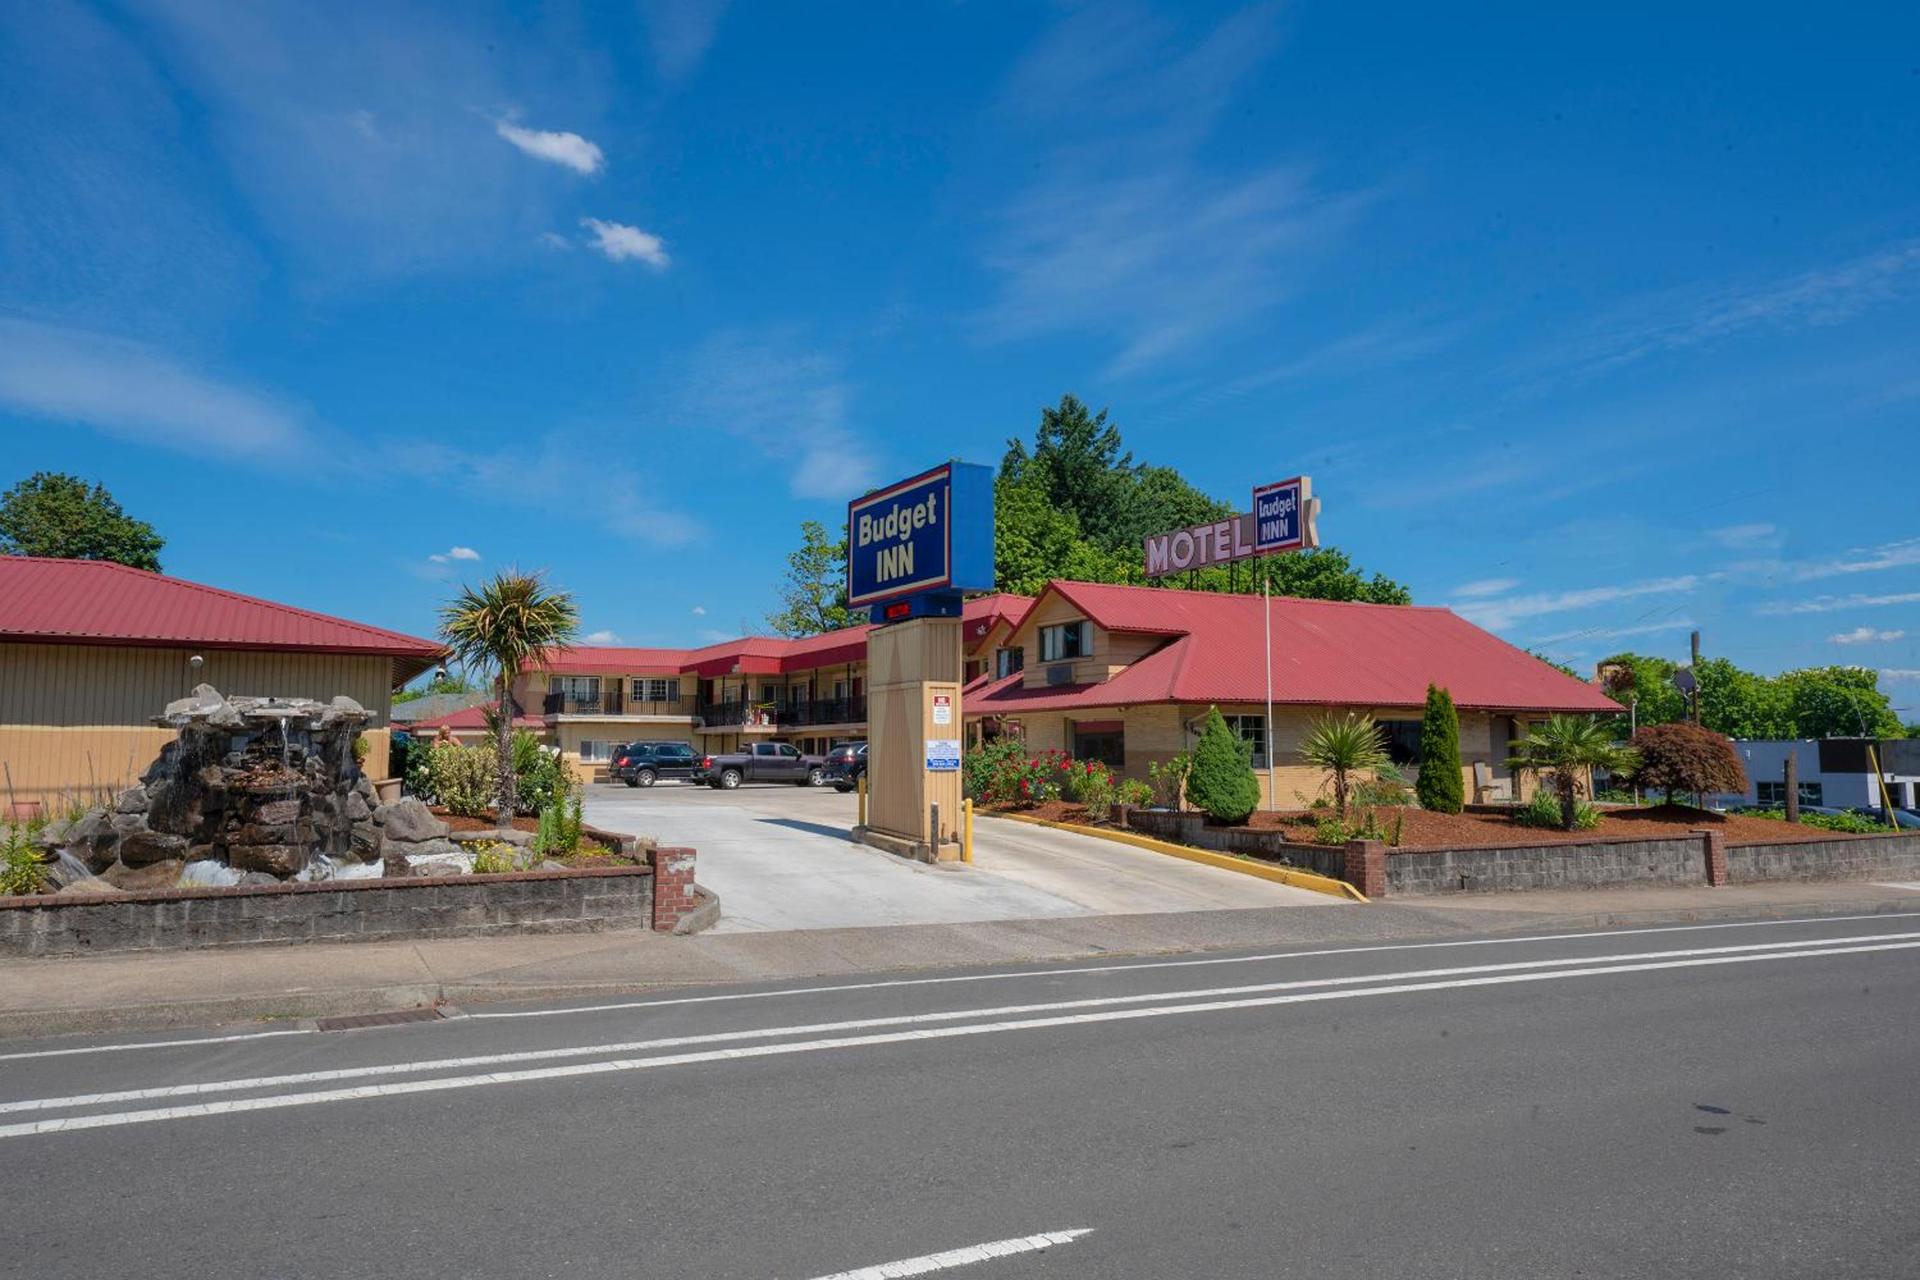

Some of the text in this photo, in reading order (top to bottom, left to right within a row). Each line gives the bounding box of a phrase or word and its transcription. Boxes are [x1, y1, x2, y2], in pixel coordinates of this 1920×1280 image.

[858, 492, 936, 547] Budget
[1147, 518, 1252, 574] MOTEL
[876, 541, 914, 583] INN
